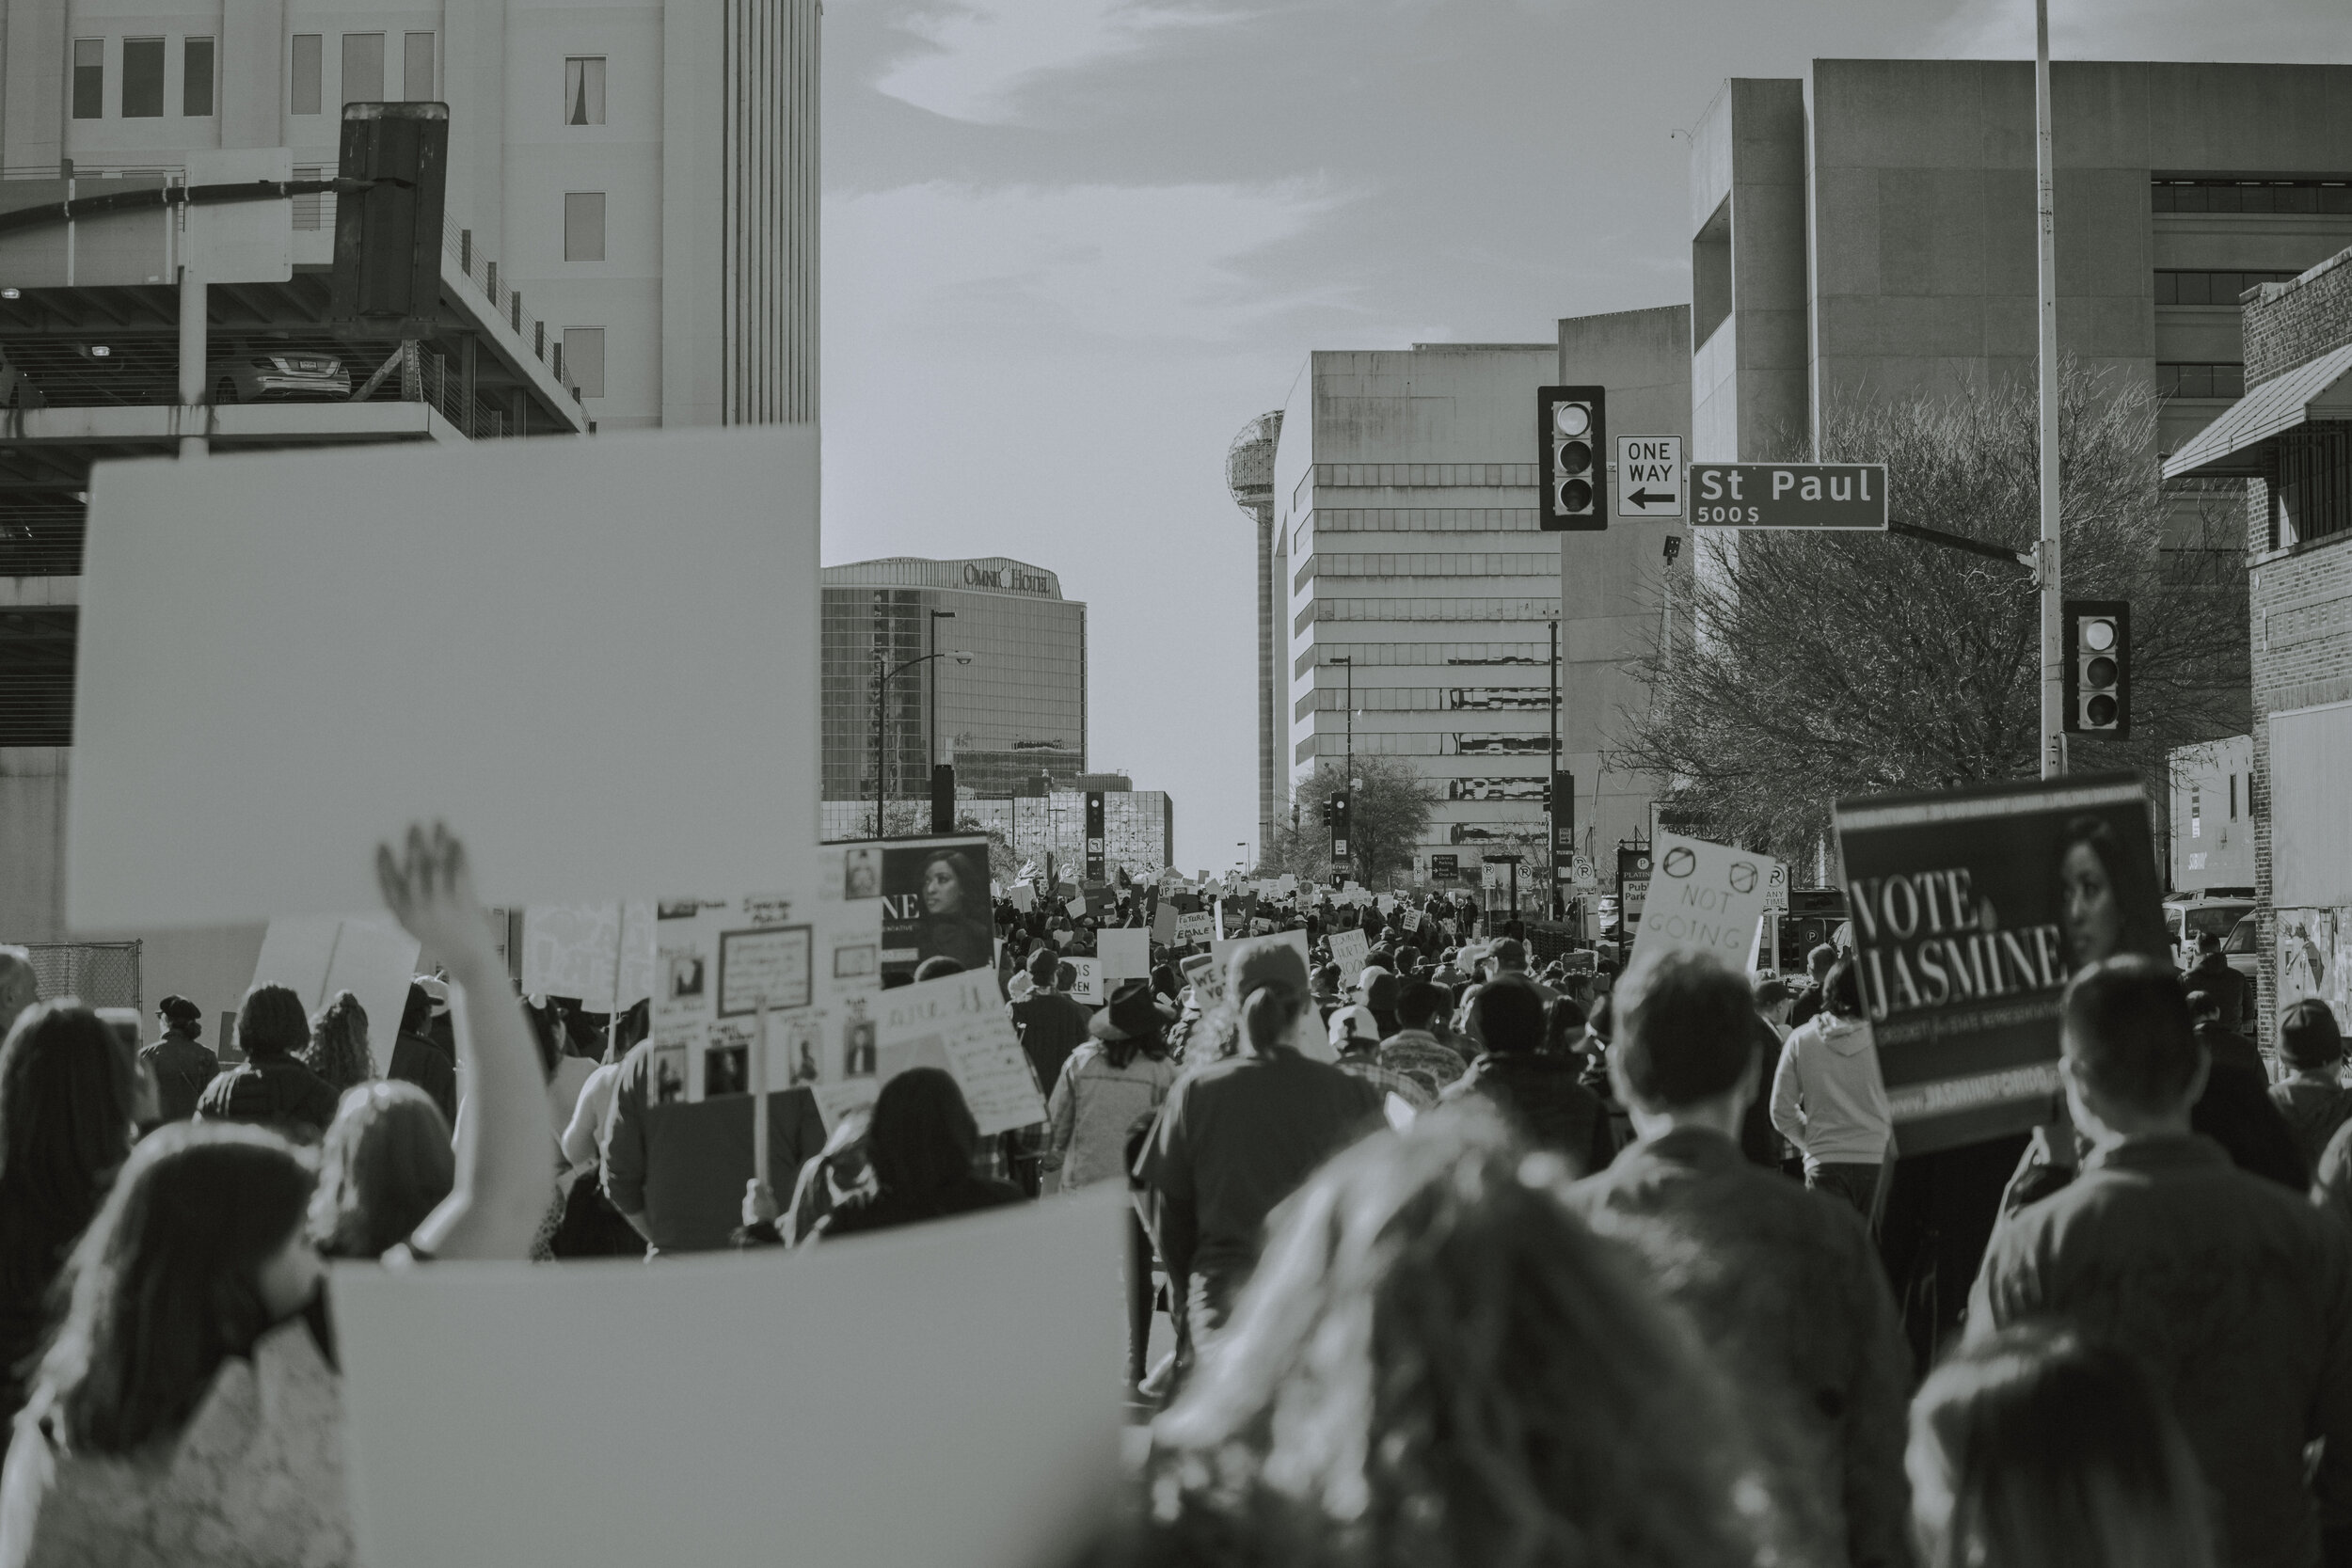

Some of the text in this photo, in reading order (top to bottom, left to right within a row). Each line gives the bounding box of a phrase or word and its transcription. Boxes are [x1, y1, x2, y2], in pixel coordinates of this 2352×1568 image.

[1628, 442, 1671, 461] ONE
[1629, 465, 1672, 483] WAY
[1700, 468, 1871, 501] St Paul
[881, 894, 920, 919] NE
[1625, 892, 1646, 901] Park
[1681, 882, 1735, 915] NOT
[1849, 865, 1980, 942] VOTE
[1174, 927, 1210, 940] EMALE
[1647, 911, 1741, 950] GOING
[1864, 923, 2070, 1022] JASMINE
[1072, 981, 1089, 991] REN
